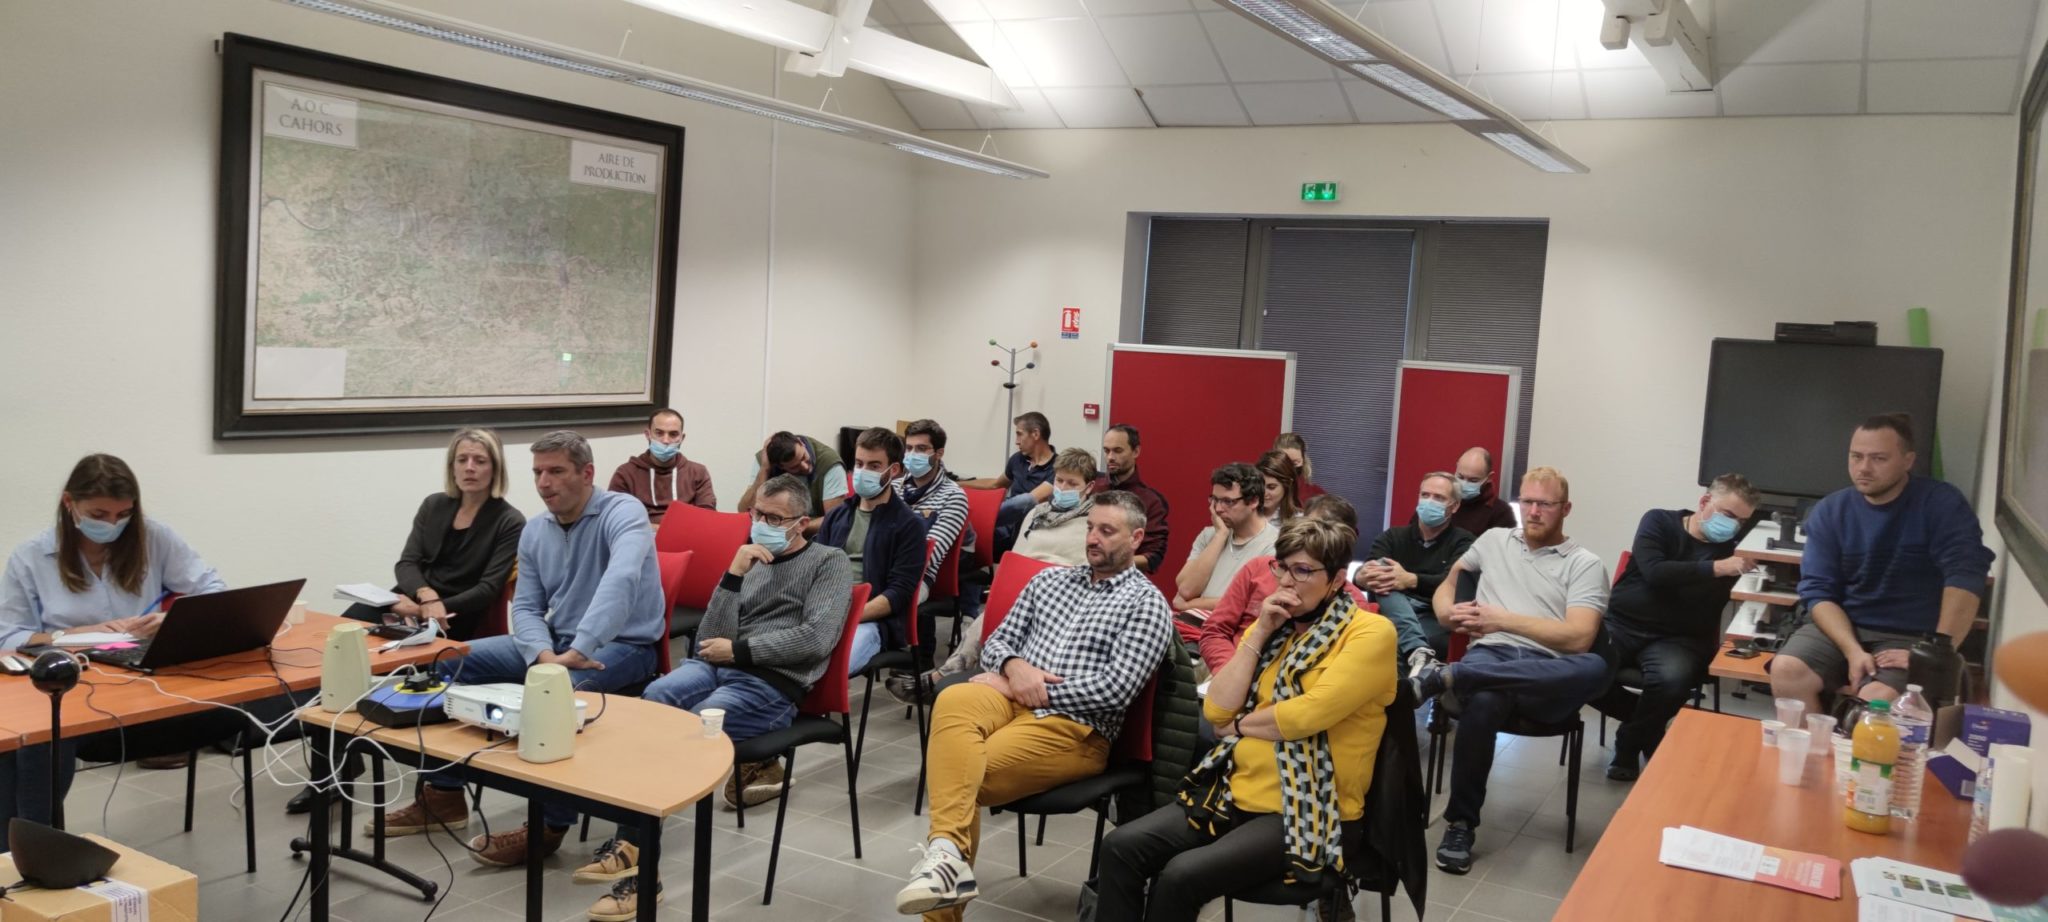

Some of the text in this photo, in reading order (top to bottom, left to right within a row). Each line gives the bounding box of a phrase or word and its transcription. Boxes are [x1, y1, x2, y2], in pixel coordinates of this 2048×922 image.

[279, 114, 344, 137] CAHORS
[598, 152, 636, 168] AIRE DE
[583, 164, 646, 184] PRODUCTION
